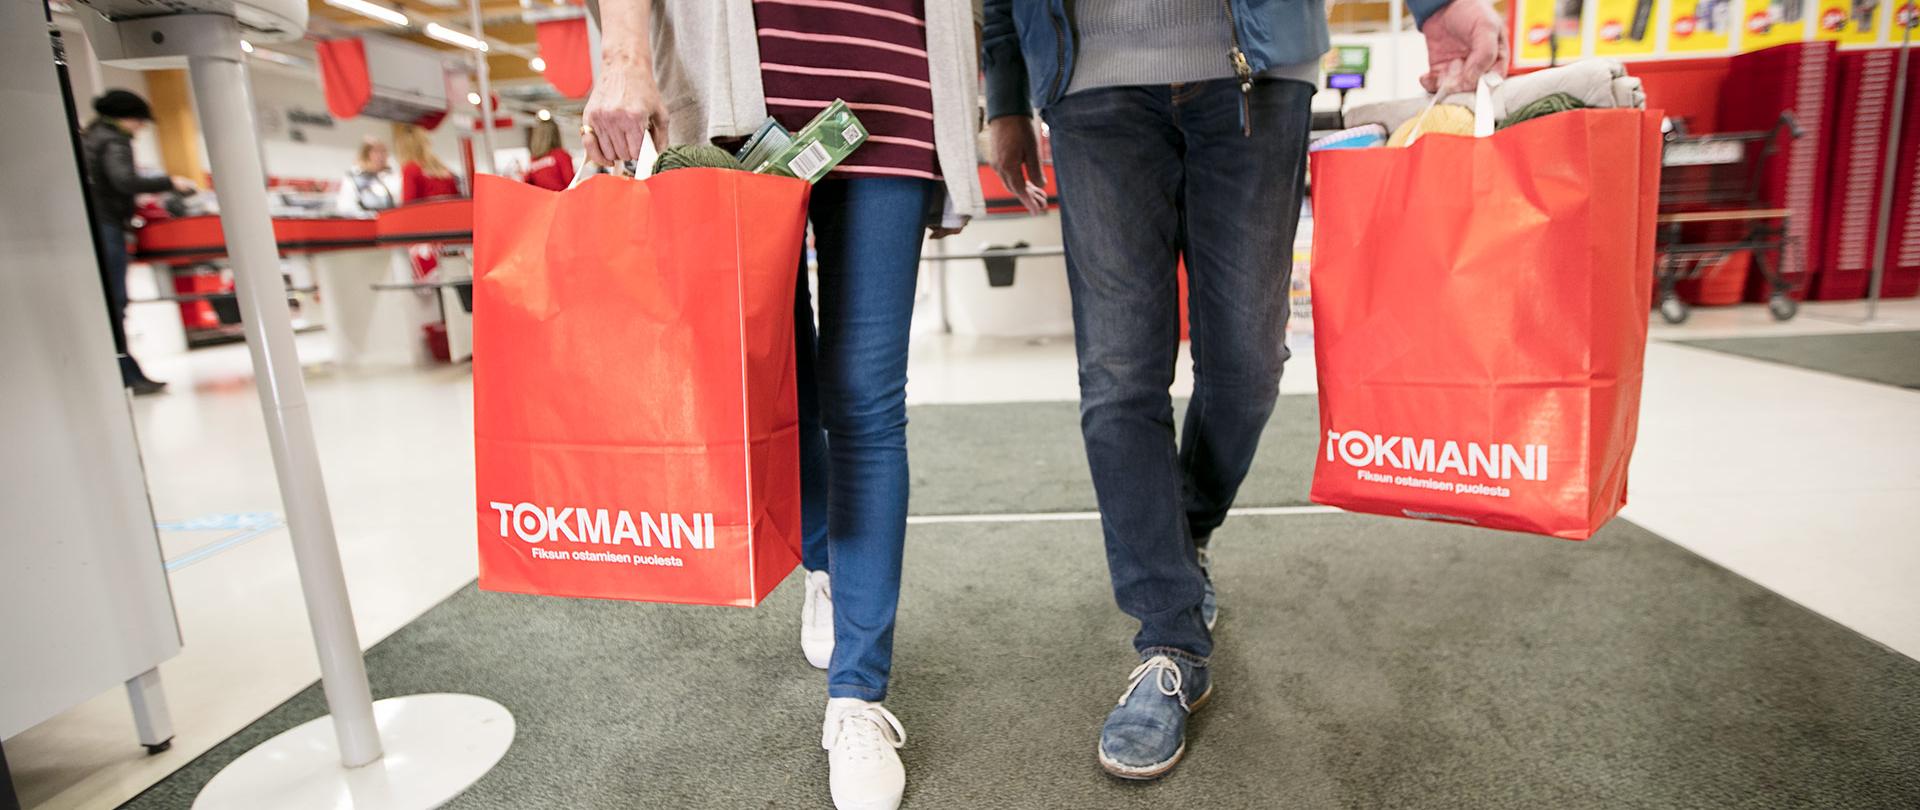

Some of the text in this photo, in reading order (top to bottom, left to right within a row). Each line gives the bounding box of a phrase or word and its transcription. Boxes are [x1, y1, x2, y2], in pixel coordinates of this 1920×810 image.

[1357, 470, 1510, 498] Fiksun ostamisen puolesta
[490, 501, 715, 549] TOKMANNI
[532, 547, 683, 567] Fiksun ostamisen puolesta
